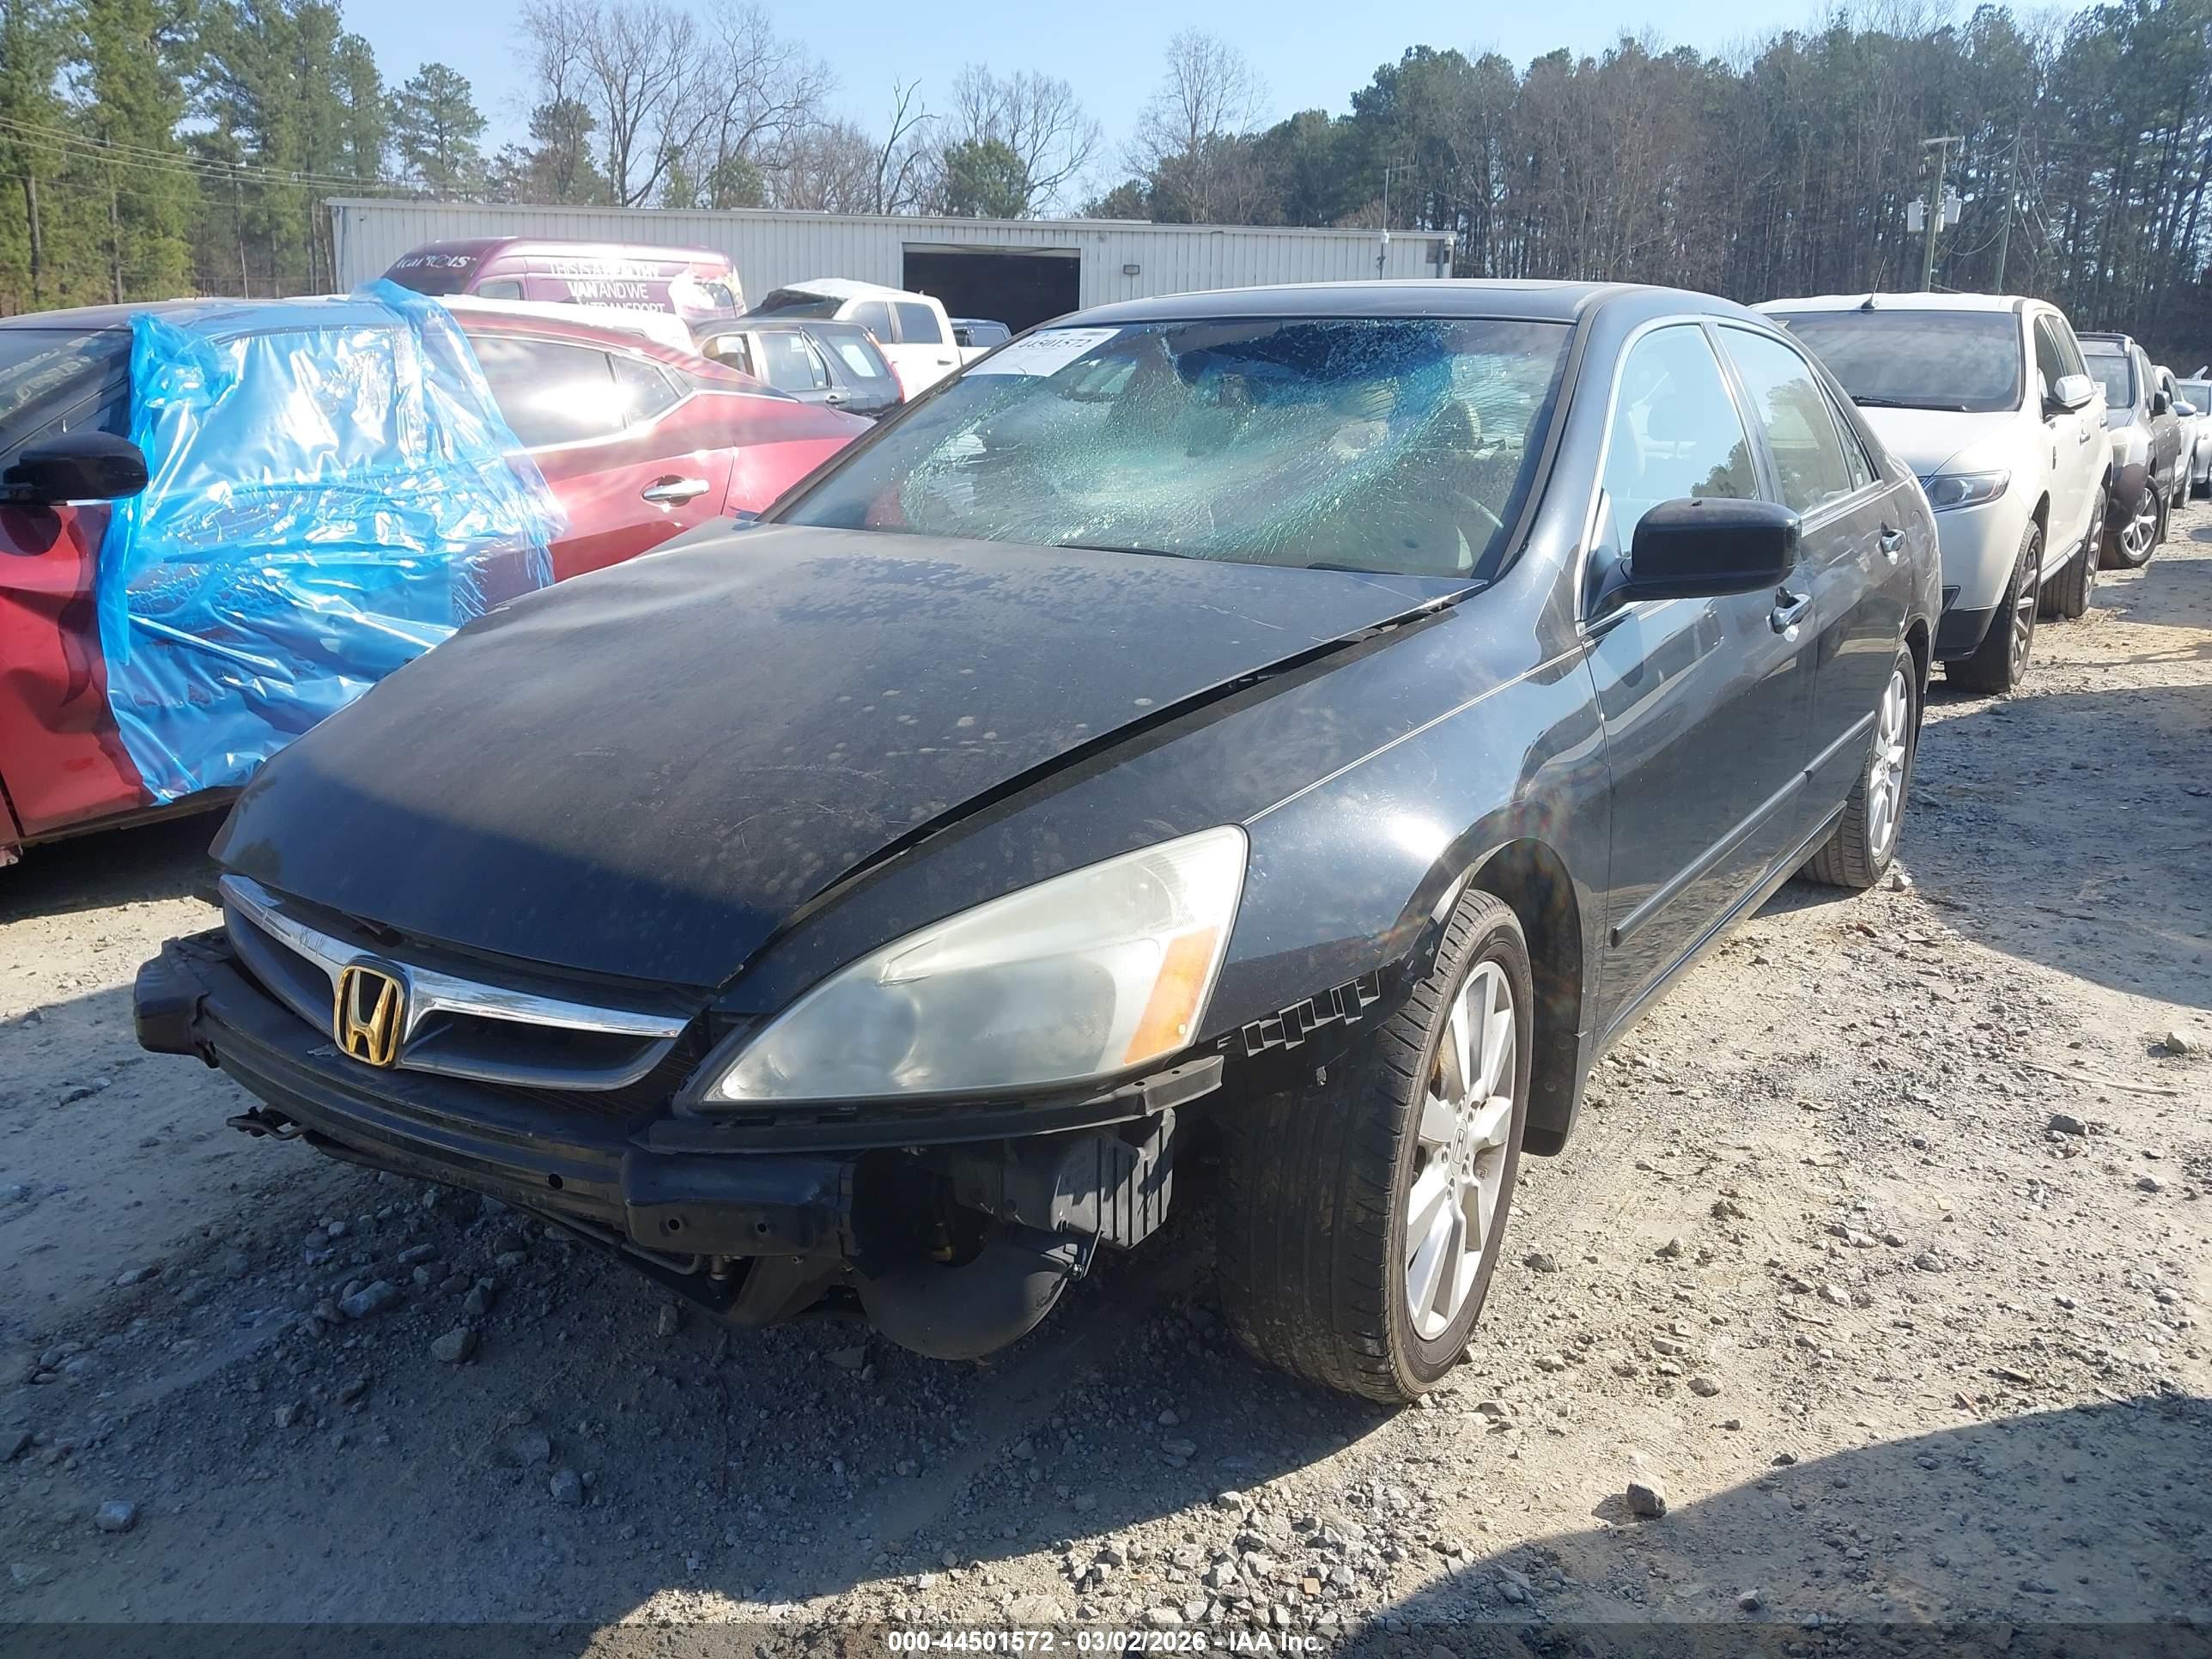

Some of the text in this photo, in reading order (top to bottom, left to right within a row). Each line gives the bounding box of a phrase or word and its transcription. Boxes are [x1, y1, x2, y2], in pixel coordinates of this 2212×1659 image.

[566, 280, 649, 299] VAN AND WE
